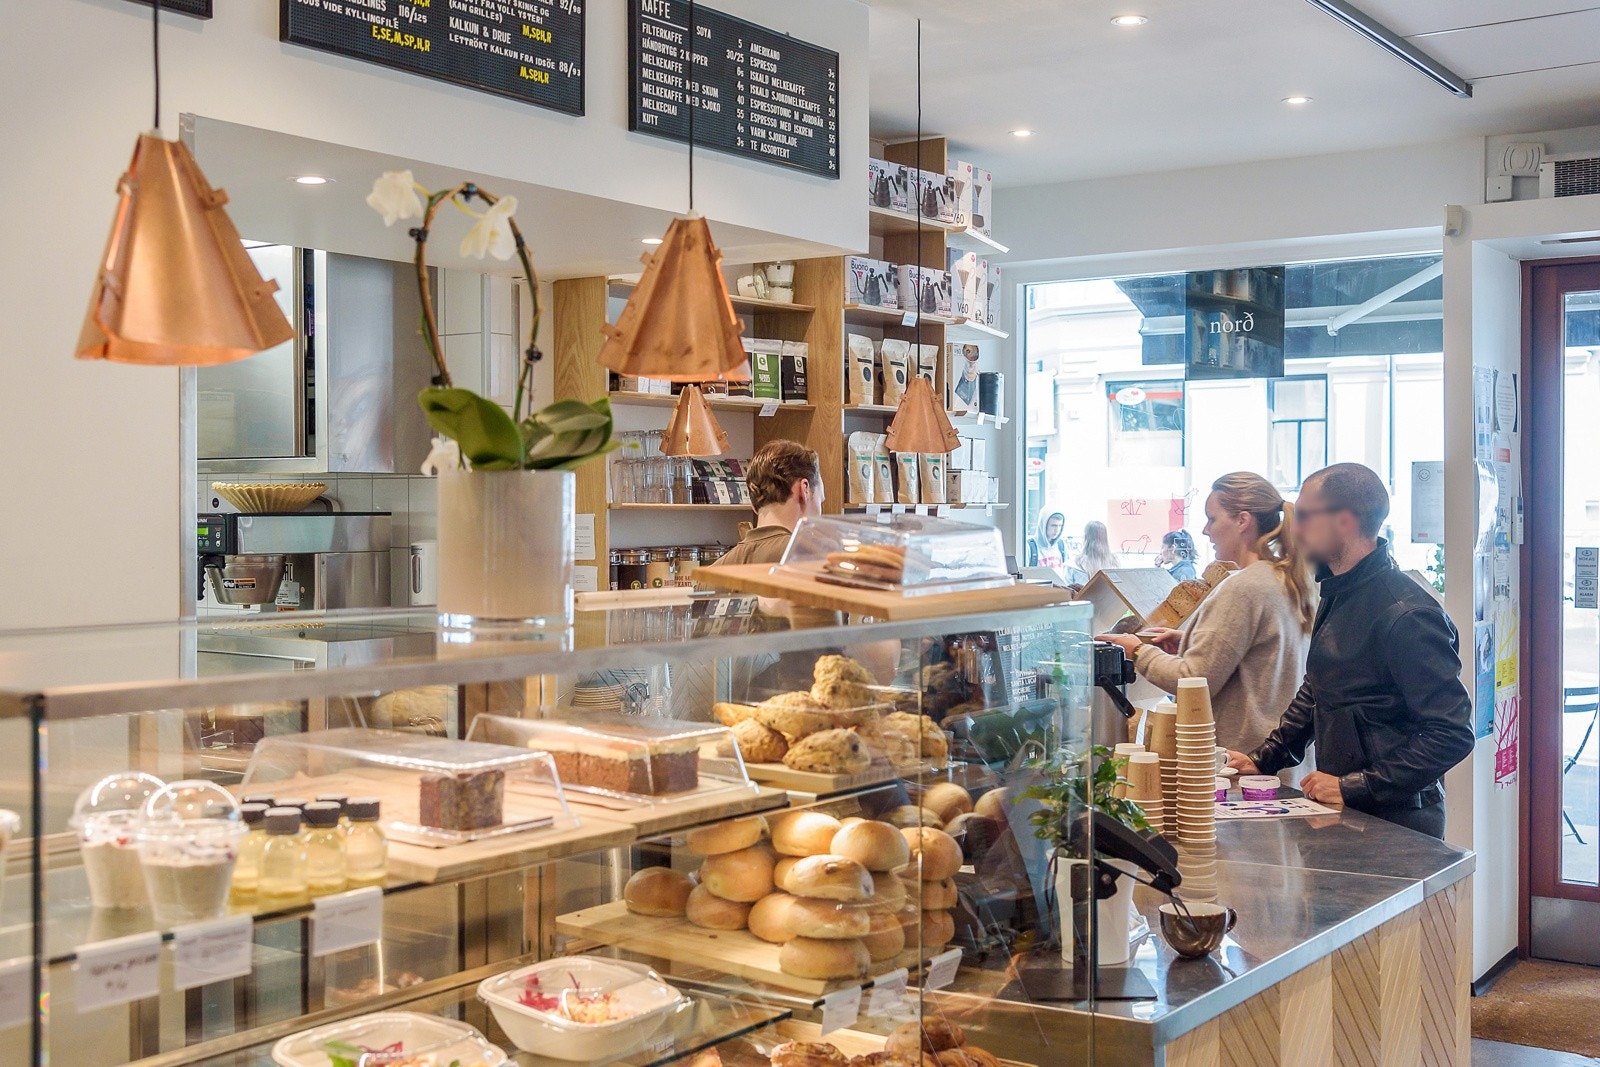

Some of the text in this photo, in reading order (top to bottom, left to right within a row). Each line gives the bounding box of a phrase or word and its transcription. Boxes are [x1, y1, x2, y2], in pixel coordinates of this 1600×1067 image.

[323, 1, 343, 14] VIDE
[398, 4, 429, 23] 116/125
[469, 6, 503, 24] GRILLES)
[481, 0, 543, 24] FRA VOLL YSTERI
[539, 8, 550, 17] OG
[641, 0, 671, 19] KAFFE
[449, 16, 512, 45] KALKUN & DRUE
[642, 22, 745, 63] FILTERKAFFE 30/25
[696, 25, 743, 49] SOYA 5
[490, 44, 519, 60] KALKUN
[520, 52, 534, 64] FRA
[558, 61, 581, 78] 88/93
[680, 49, 685, 60] 2
[685, 50, 709, 67] KPPER
[750, 43, 780, 61] AMERIKANO
[642, 53, 745, 92] MELKEKAFFE 45
[750, 56, 836, 92] ESPRESSO 22
[750, 70, 770, 85] ISKALD
[771, 77, 806, 96] MELKEKAFFE
[642, 68, 683, 88] MELKEKAFFE
[702, 85, 719, 99] SKUM
[736, 95, 745, 105] 40
[642, 83, 683, 103] MELKEKAFFE
[702, 99, 721, 113] SJOKO
[736, 109, 745, 119] 55
[750, 84, 770, 99] ISKALD
[828, 107, 836, 118] 50
[642, 98, 745, 133] MELKECHAI 45
[750, 98, 792, 119] ESPRESSOTONIC
[828, 121, 836, 131] 55
[642, 112, 745, 147] KUTT 35
[750, 112, 836, 144] ESPRESSO MED ISKREM 55
[750, 126, 766, 139] VARM
[767, 131, 798, 148] SJOKOLADE
[750, 140, 758, 151] TE
[760, 142, 790, 159] ASSORTERT
[957, 302, 969, 314] V60
[1209, 311, 1254, 334] norð
